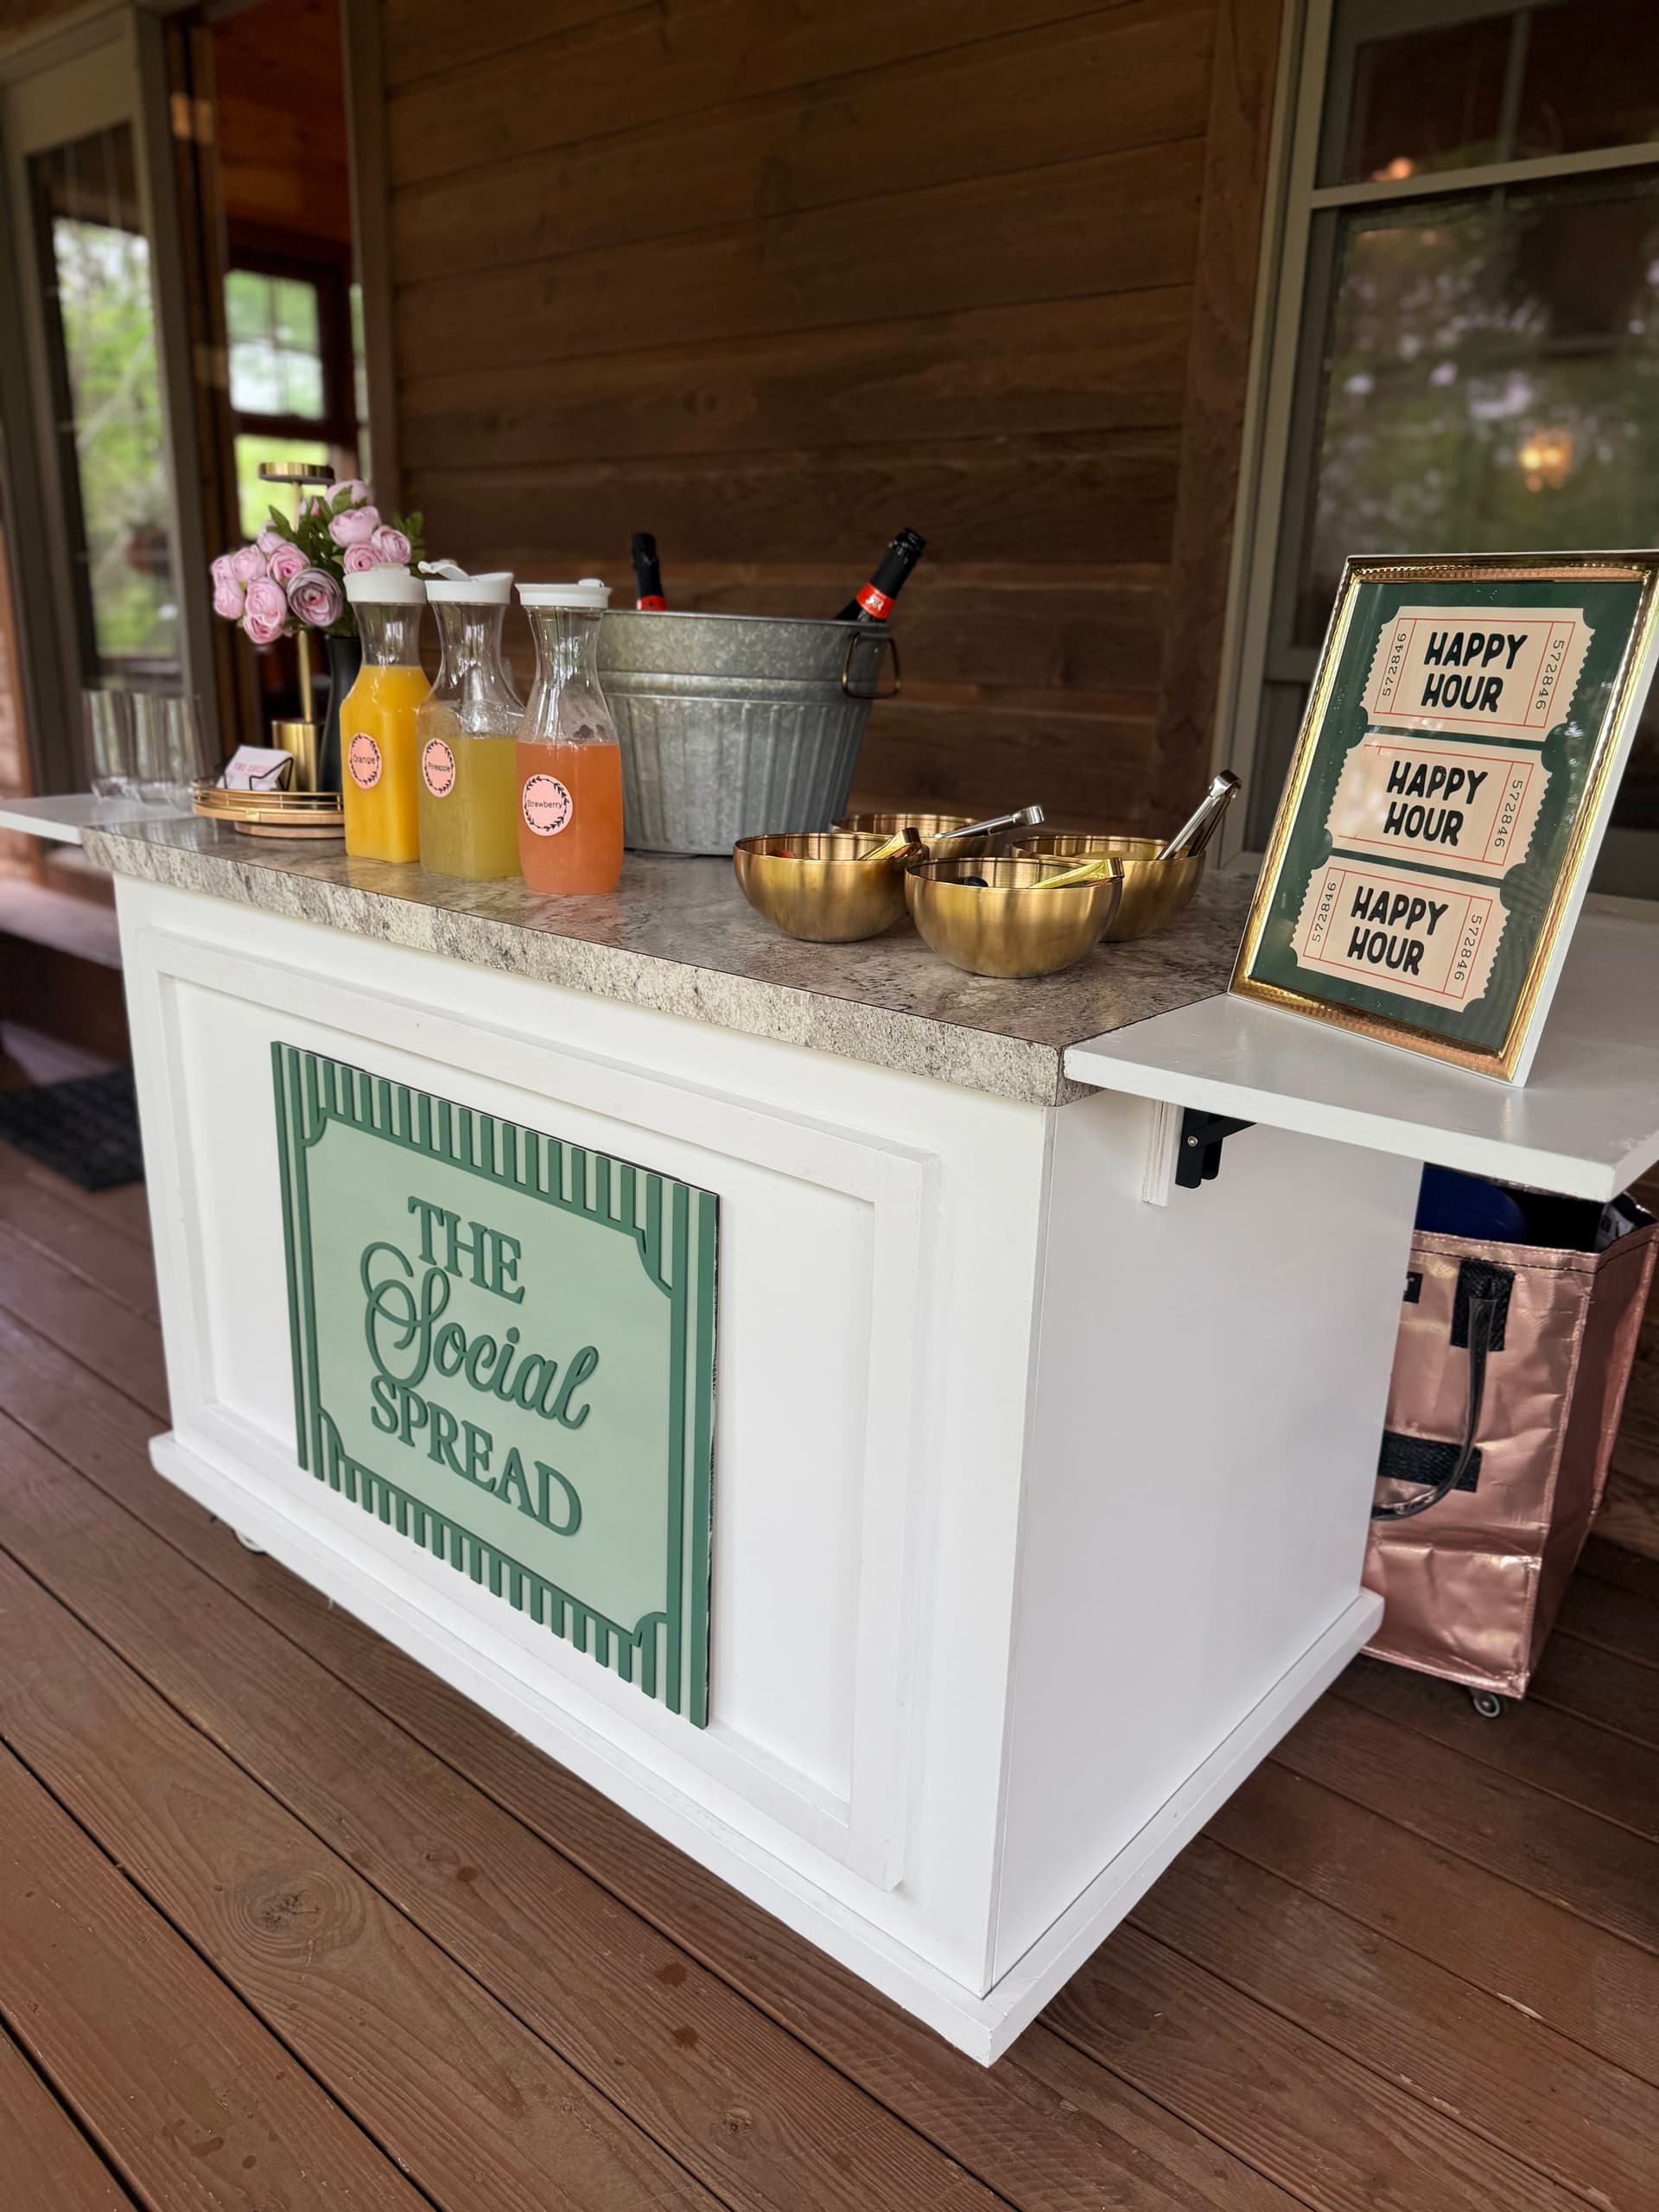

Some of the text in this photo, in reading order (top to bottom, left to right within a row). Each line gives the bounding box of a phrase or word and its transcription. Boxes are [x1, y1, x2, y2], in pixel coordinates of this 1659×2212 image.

[1382, 632, 1407, 696] 572846
[1424, 632, 1529, 670] HAPPY
[1535, 639, 1565, 710] 572846
[1421, 673, 1503, 713] HOUR
[353, 753, 376, 766] Orange
[1386, 760, 1488, 804] HAPPY
[527, 799, 563, 809] Strawberry
[1383, 801, 1464, 847] HOUR
[1494, 779, 1522, 848] 572846
[1312, 882, 1337, 943] 572846
[1351, 886, 1449, 936] HAPPY
[1347, 926, 1425, 976] HOUR
[1454, 913, 1483, 982] 572846
[407, 1195, 525, 1305] THE
[360, 1241, 599, 1431] Social
[370, 1375, 582, 1538] SPREAD
